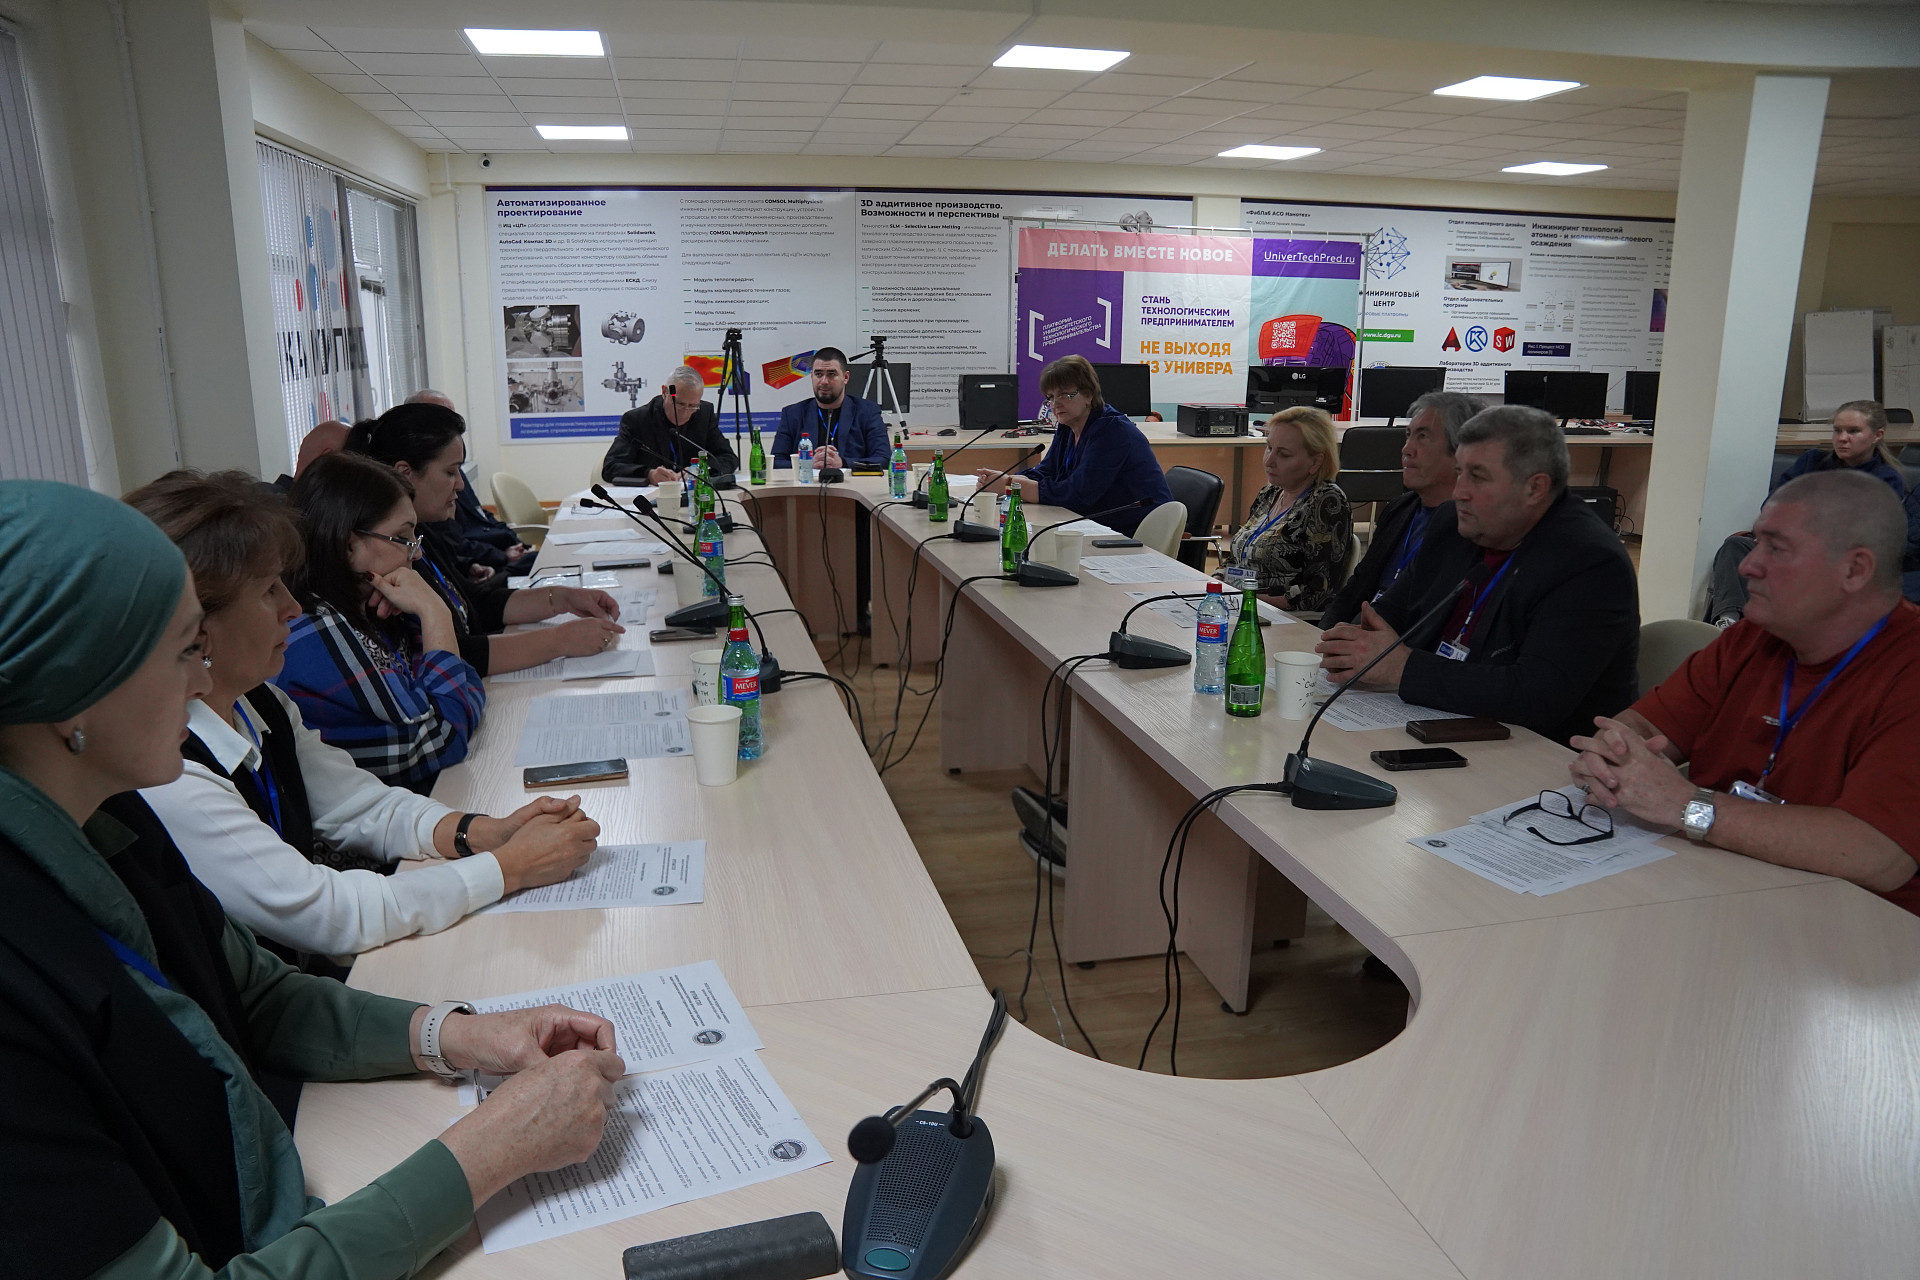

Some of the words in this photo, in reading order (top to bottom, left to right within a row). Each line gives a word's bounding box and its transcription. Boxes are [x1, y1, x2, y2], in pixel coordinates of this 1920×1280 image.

[497, 200, 606, 208] Автоматизированное
[498, 209, 582, 218] проектирование
[937, 212, 1000, 220] перспективы
[1532, 223, 1579, 232] Инжиниринг
[1570, 235, 1653, 243] молекулярно-слоевого
[1047, 243, 1108, 257] ДЕЛАТЬ
[1114, 246, 1174, 260] ВМЕСТЕ
[1179, 248, 1233, 262] НОВОЕ
[1264, 252, 1355, 264] UniverTechPred.ru
[1142, 296, 1171, 304] СТАНЬ
[1141, 307, 1230, 317] ТЕХНОЛОГИЧЕСКИМ
[1043, 317, 1072, 330] ПЛАТФОРМА
[1043, 316, 1092, 336] УНИВЕРСИТЕТСКОГО
[1141, 318, 1234, 327] ПРЕДПРИНИМАТЕЛЕМ
[1043, 321, 1092, 341] ТЕХНОЛОГИЧЕСКОГО
[1043, 324, 1102, 347] ПРЕДПРИНИМАТЕЛЬСТВА
[1140, 341, 1160, 354] НЕ
[1165, 342, 1231, 356] ВЫХОДЯ
[1140, 360, 1160, 374] З
[1164, 361, 1233, 375] УНИВЕРА
[735, 681, 757, 690] MEVER
